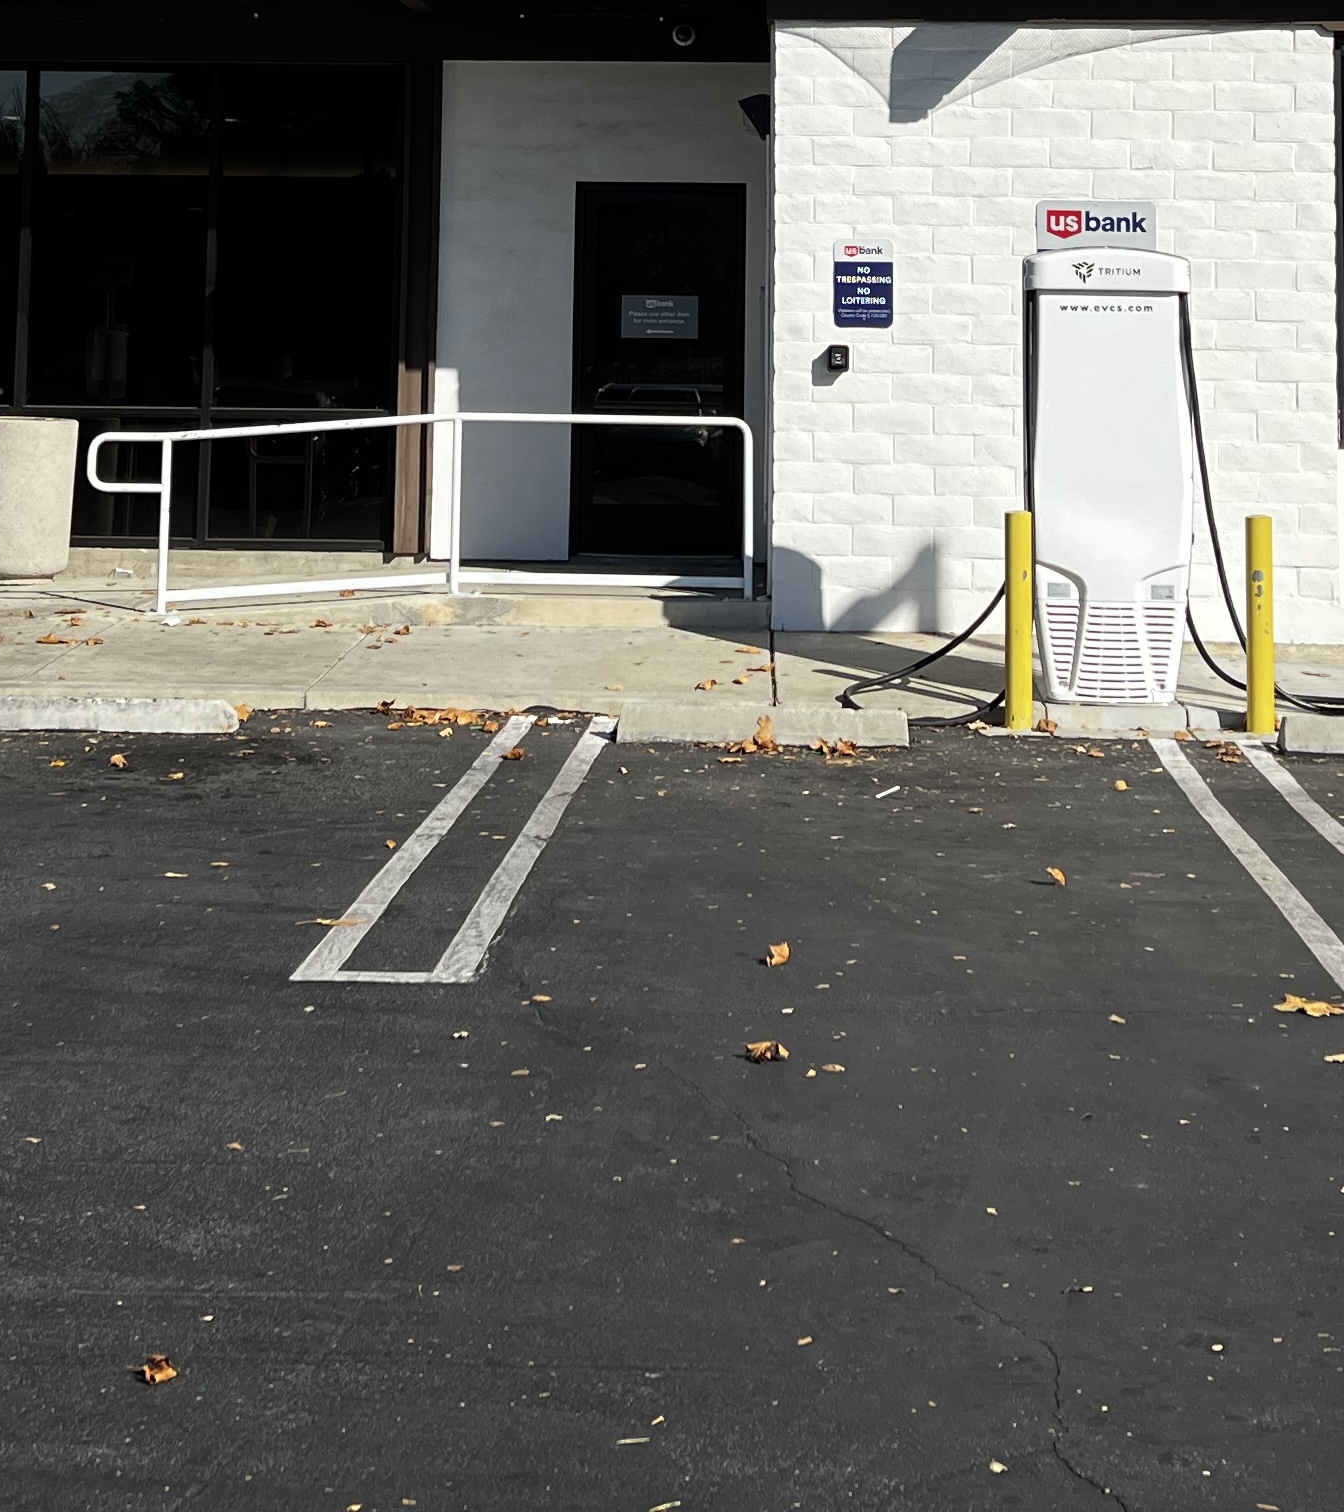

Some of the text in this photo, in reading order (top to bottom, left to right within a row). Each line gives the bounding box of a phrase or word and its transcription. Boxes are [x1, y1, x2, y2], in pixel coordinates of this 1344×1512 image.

[1085, 211, 1147, 233] bank
[859, 246, 883, 254] bank
[857, 266, 871, 274] NO
[1098, 268, 1141, 276] TRITIUM
[836, 276, 892, 284] TRESPASSING
[857, 287, 871, 295] NO
[841, 296, 886, 305] LOITERING
[1059, 304, 1154, 312] www.evcs.com
